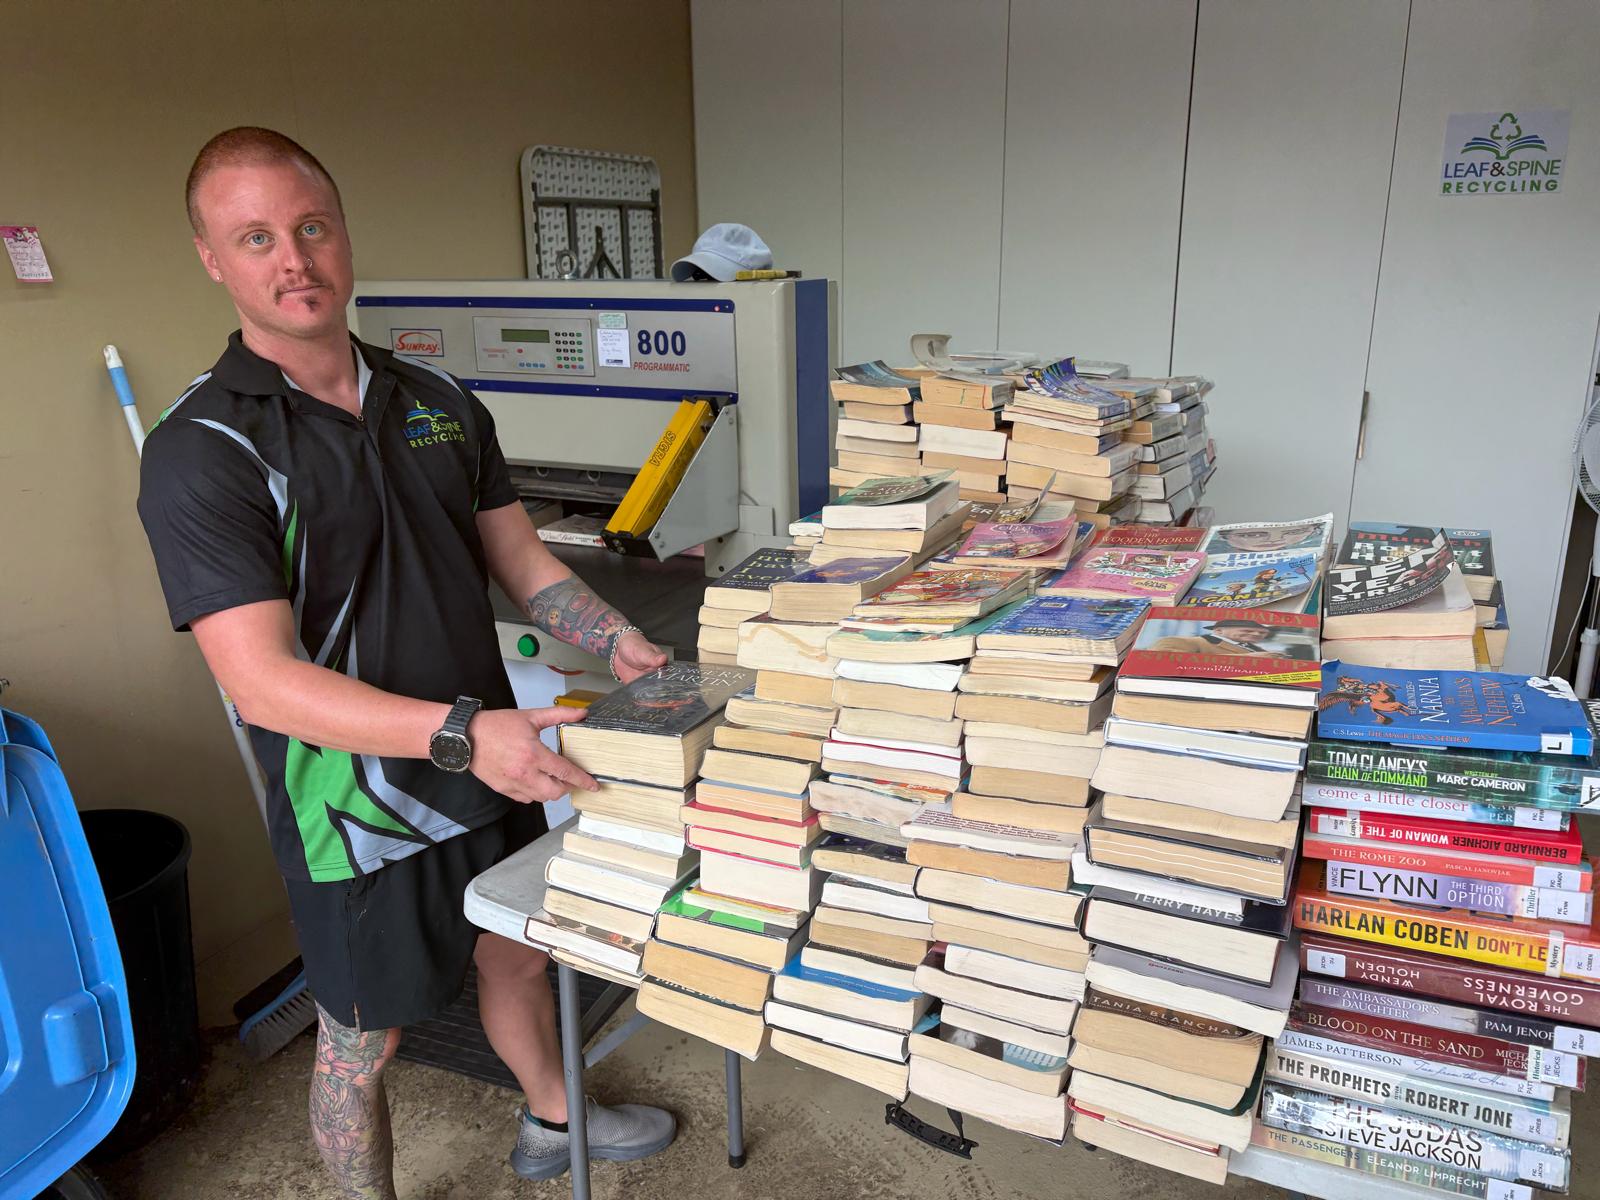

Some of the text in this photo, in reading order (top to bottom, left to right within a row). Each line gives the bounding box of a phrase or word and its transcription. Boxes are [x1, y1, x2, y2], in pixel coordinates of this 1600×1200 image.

[1443, 160, 1562, 178] LEAF&SPINE
[1442, 180, 1558, 193] RECYCLING
[637, 329, 687, 356] 800
[633, 361, 690, 372] PROGRAMMATIC
[1102, 536, 1197, 545] WOODEN HORSE
[648, 671, 737, 687] MARTIN
[1418, 677, 1450, 724] NARNIA
[1327, 750, 1428, 776] TOM CLANCY'S
[1327, 765, 1428, 788] CHAIN OF COMMAND
[1436, 774, 1526, 792] MARC CAMERON
[1318, 788, 1469, 812] come a little closer
[1489, 812, 1514, 823] PER
[1366, 825, 1386, 837] THE
[1389, 829, 1402, 839] OF
[1405, 829, 1449, 845] WOMAN
[1452, 835, 1501, 850] AICHNER
[1504, 842, 1568, 859] BERNHARD
[1330, 847, 1357, 859] THE
[1359, 850, 1396, 863] ROME
[1399, 855, 1426, 867] ZOO
[1445, 863, 1473, 872] PASCAL
[1331, 867, 1339, 887] VINCE
[1340, 868, 1438, 900] FLYNN
[1447, 889, 1505, 909] OPTION
[1451, 881, 1502, 896] THE THIRD
[1134, 892, 1245, 922] TERRY HAYES
[1526, 887, 1537, 914] Thriller
[1301, 902, 1547, 962] HARLAN COBEN DON'T LE
[1550, 944, 1561, 969] Mystery
[1355, 960, 1420, 980] HOLDEN
[1360, 971, 1415, 988] WENDY
[1314, 983, 1441, 1016] THE AMBASSADOR'S
[1463, 977, 1584, 1006] GOVERNESS
[1341, 998, 1410, 1020] DAUGHTER
[1474, 991, 1571, 1016] THE ROYAL
[1093, 996, 1142, 1013] TANIA
[1150, 1010, 1244, 1037] BLANCHAR
[1307, 1012, 1485, 1059] BLOOD ON THE SAND
[1485, 1020, 1555, 1041] PAM JENOF
[1284, 1035, 1402, 1067] JAMES PATTERSON
[1495, 1048, 1529, 1061] MICH
[1503, 1058, 1528, 1070] JECK
[1533, 1049, 1541, 1080] Historical
[1277, 1055, 1305, 1076] THE
[1309, 1064, 1392, 1099] PROPHETS
[1405, 1087, 1470, 1117] ROBERT
[1474, 1105, 1513, 1129] JONE
[1324, 1121, 1482, 1171] STEVE JACKSON
[1268, 1130, 1488, 1191] THE PASSENGERS ELEANOR LIMPRECHT
